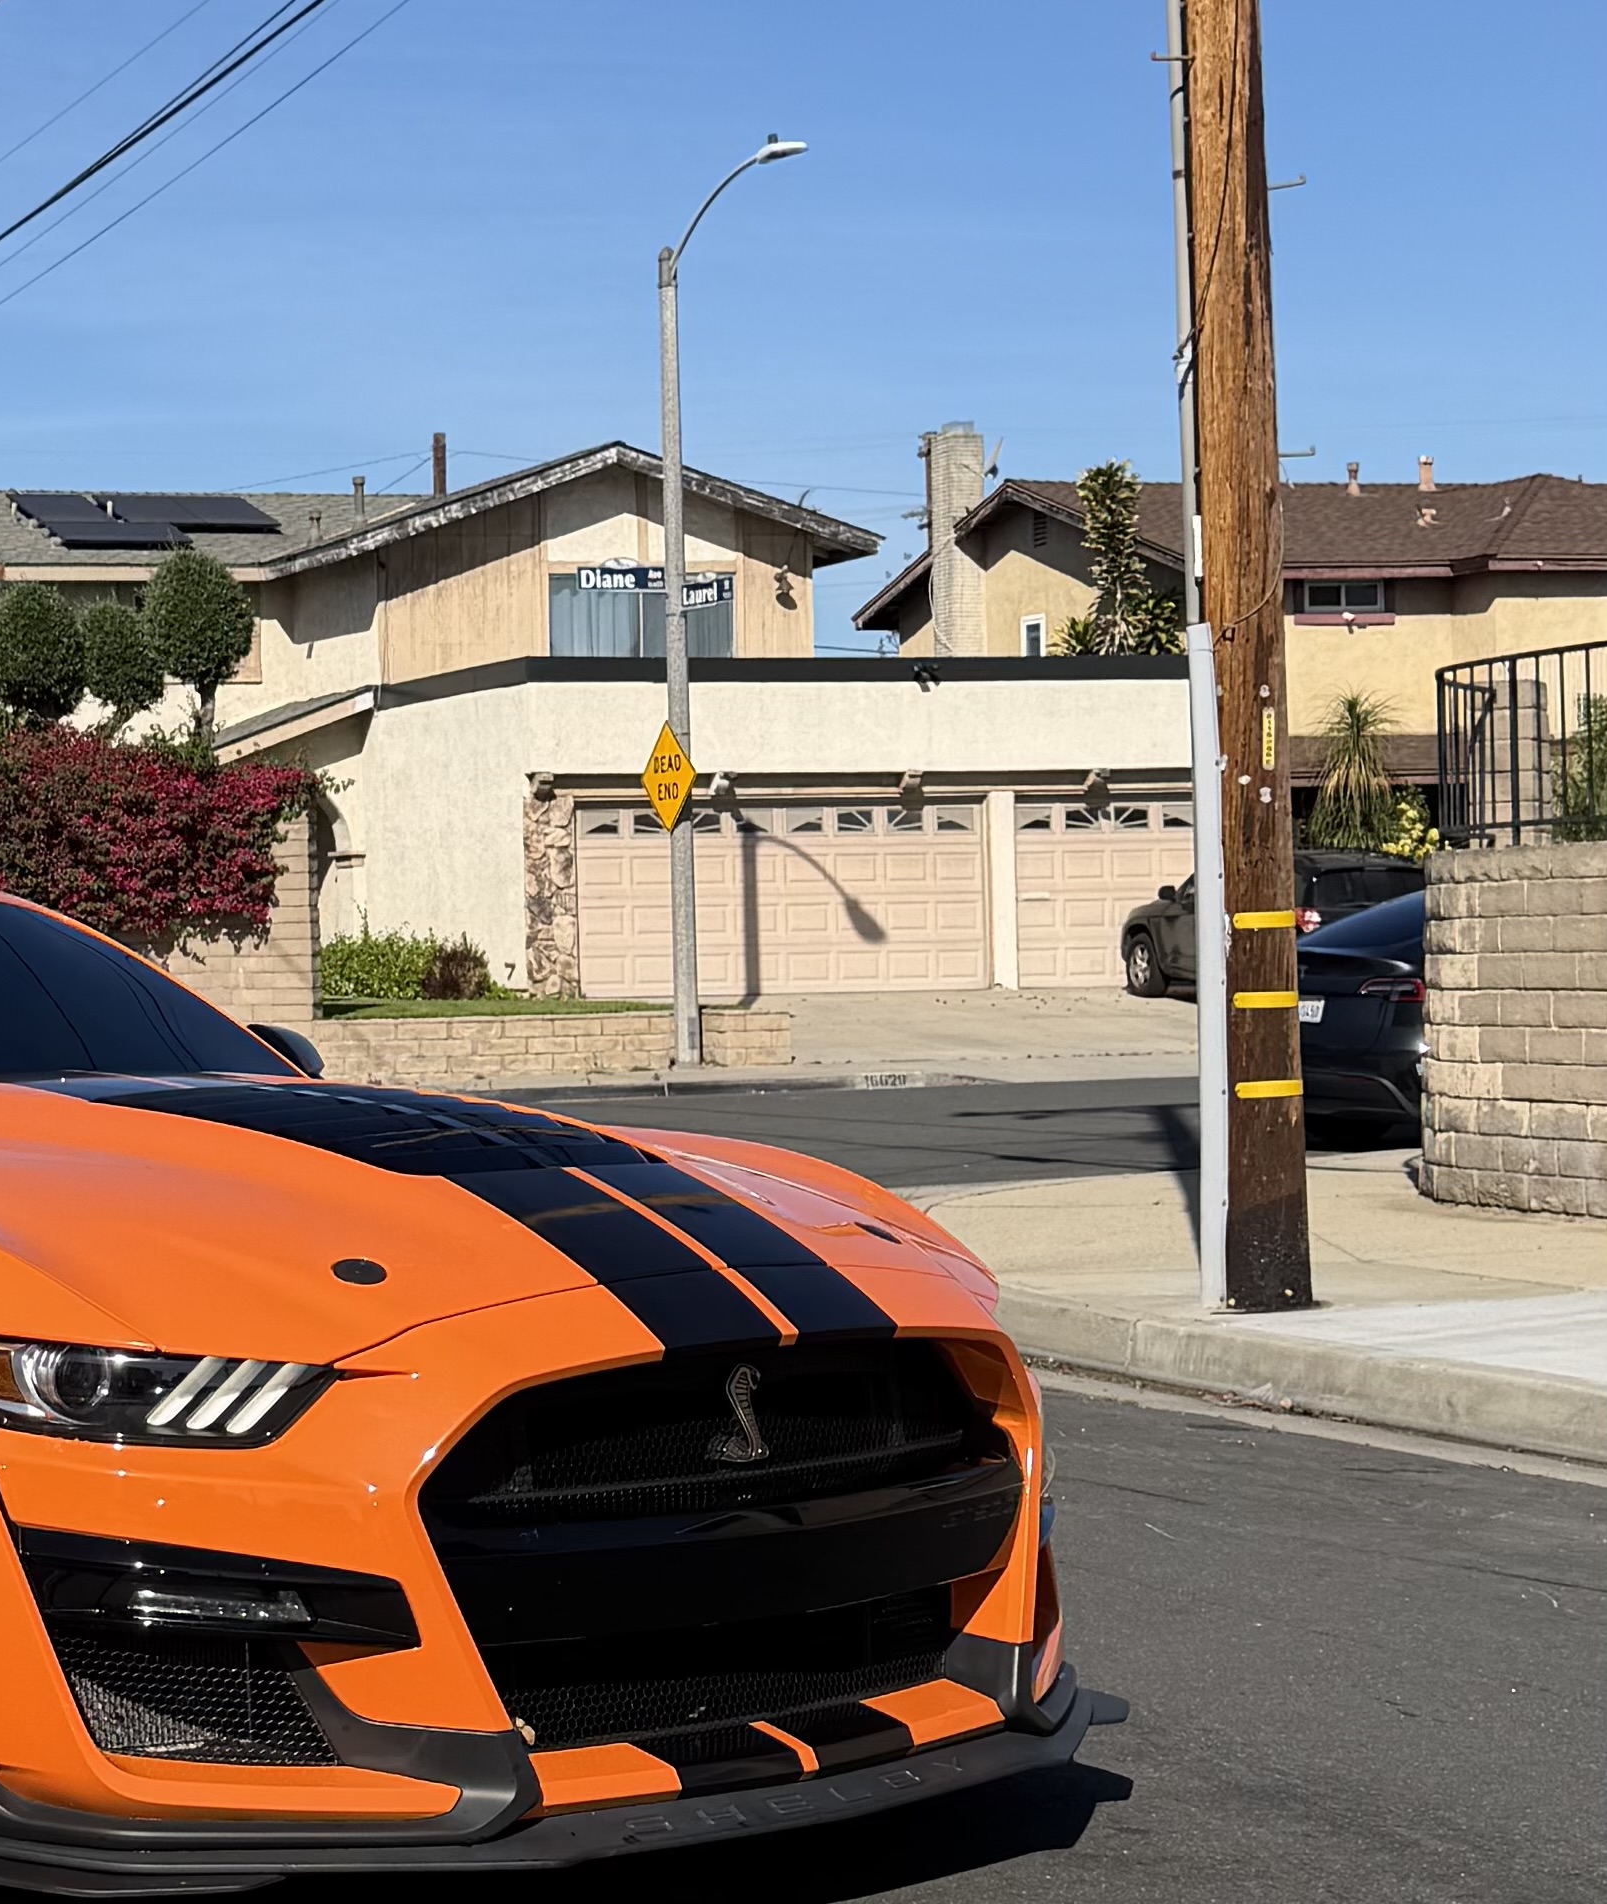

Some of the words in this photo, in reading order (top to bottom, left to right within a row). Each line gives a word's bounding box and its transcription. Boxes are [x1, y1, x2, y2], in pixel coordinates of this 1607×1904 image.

[580, 568, 636, 589] Diane
[683, 581, 718, 606] Laurel
[654, 753, 681, 774] DEAD
[657, 782, 679, 801] END
[623, 1755, 965, 1834] SHELBY
